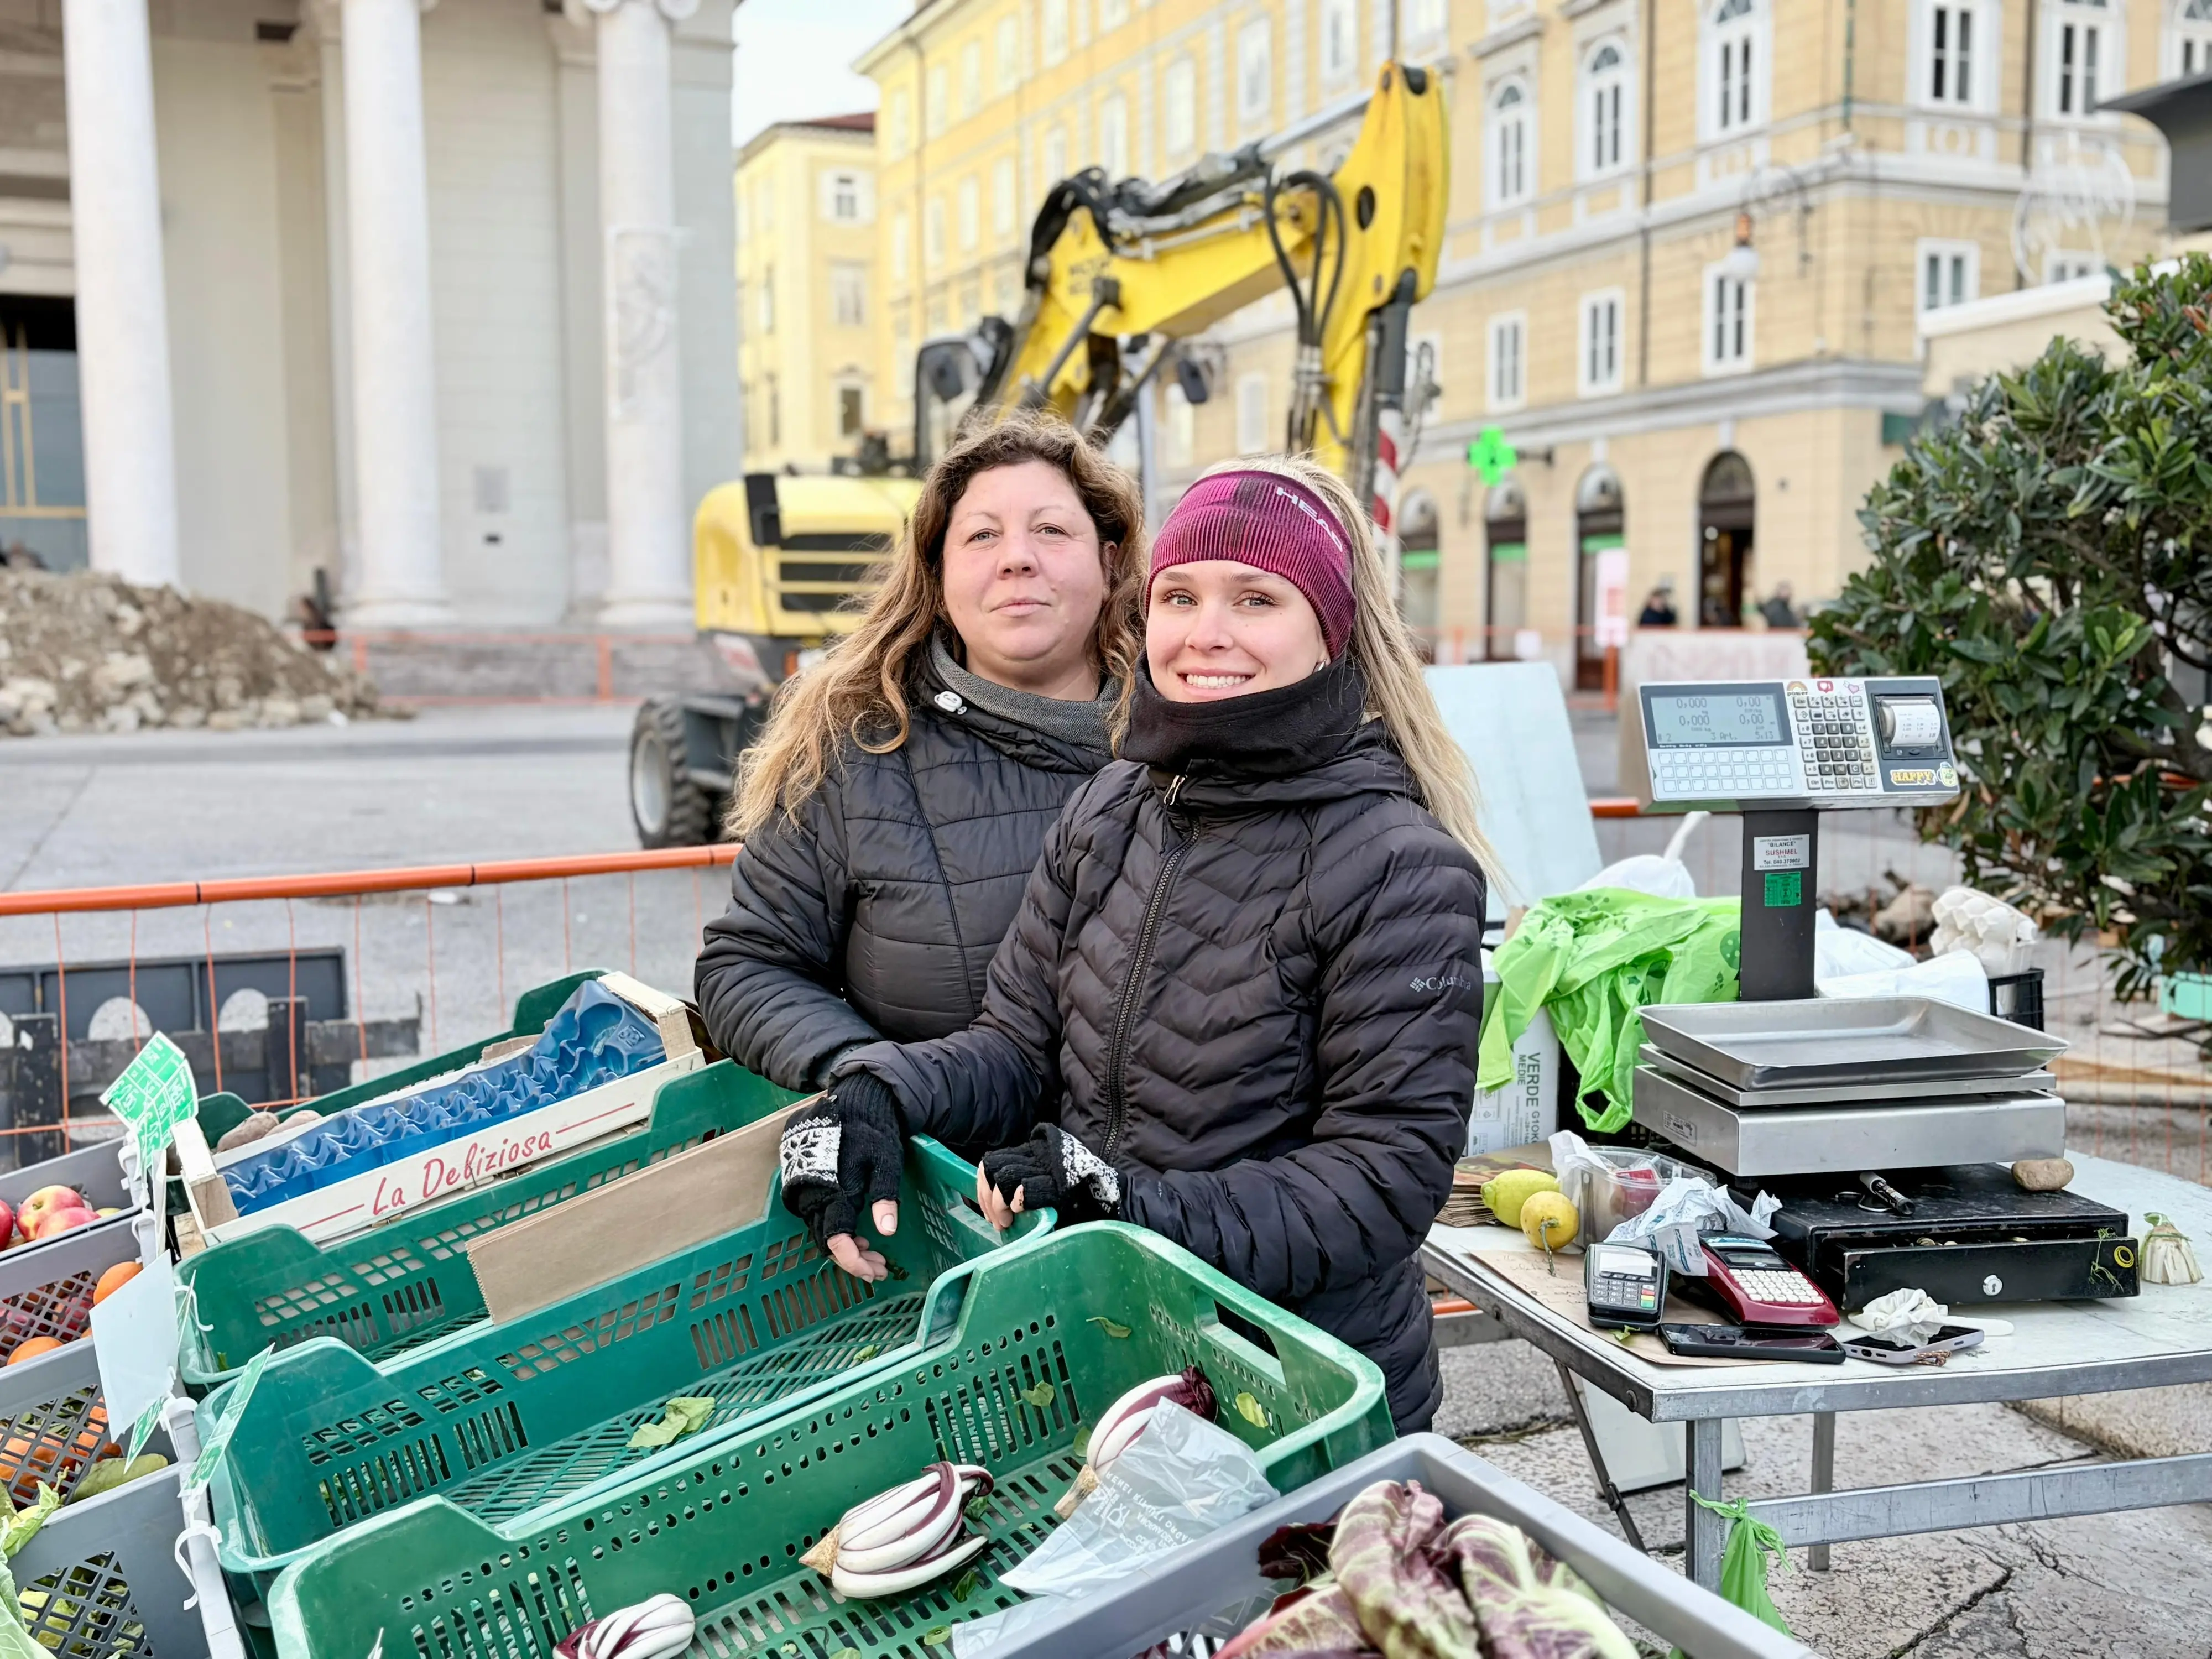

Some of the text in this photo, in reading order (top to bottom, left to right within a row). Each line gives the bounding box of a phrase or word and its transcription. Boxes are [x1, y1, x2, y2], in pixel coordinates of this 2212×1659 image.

[1276, 487, 1343, 552] HEAD
[1893, 771, 1933, 782] HAPPY
[1518, 1054, 1526, 1086] MEDIE
[1526, 1052, 1540, 1107] VERDE
[372, 1130, 553, 1216] La Deliziosa
